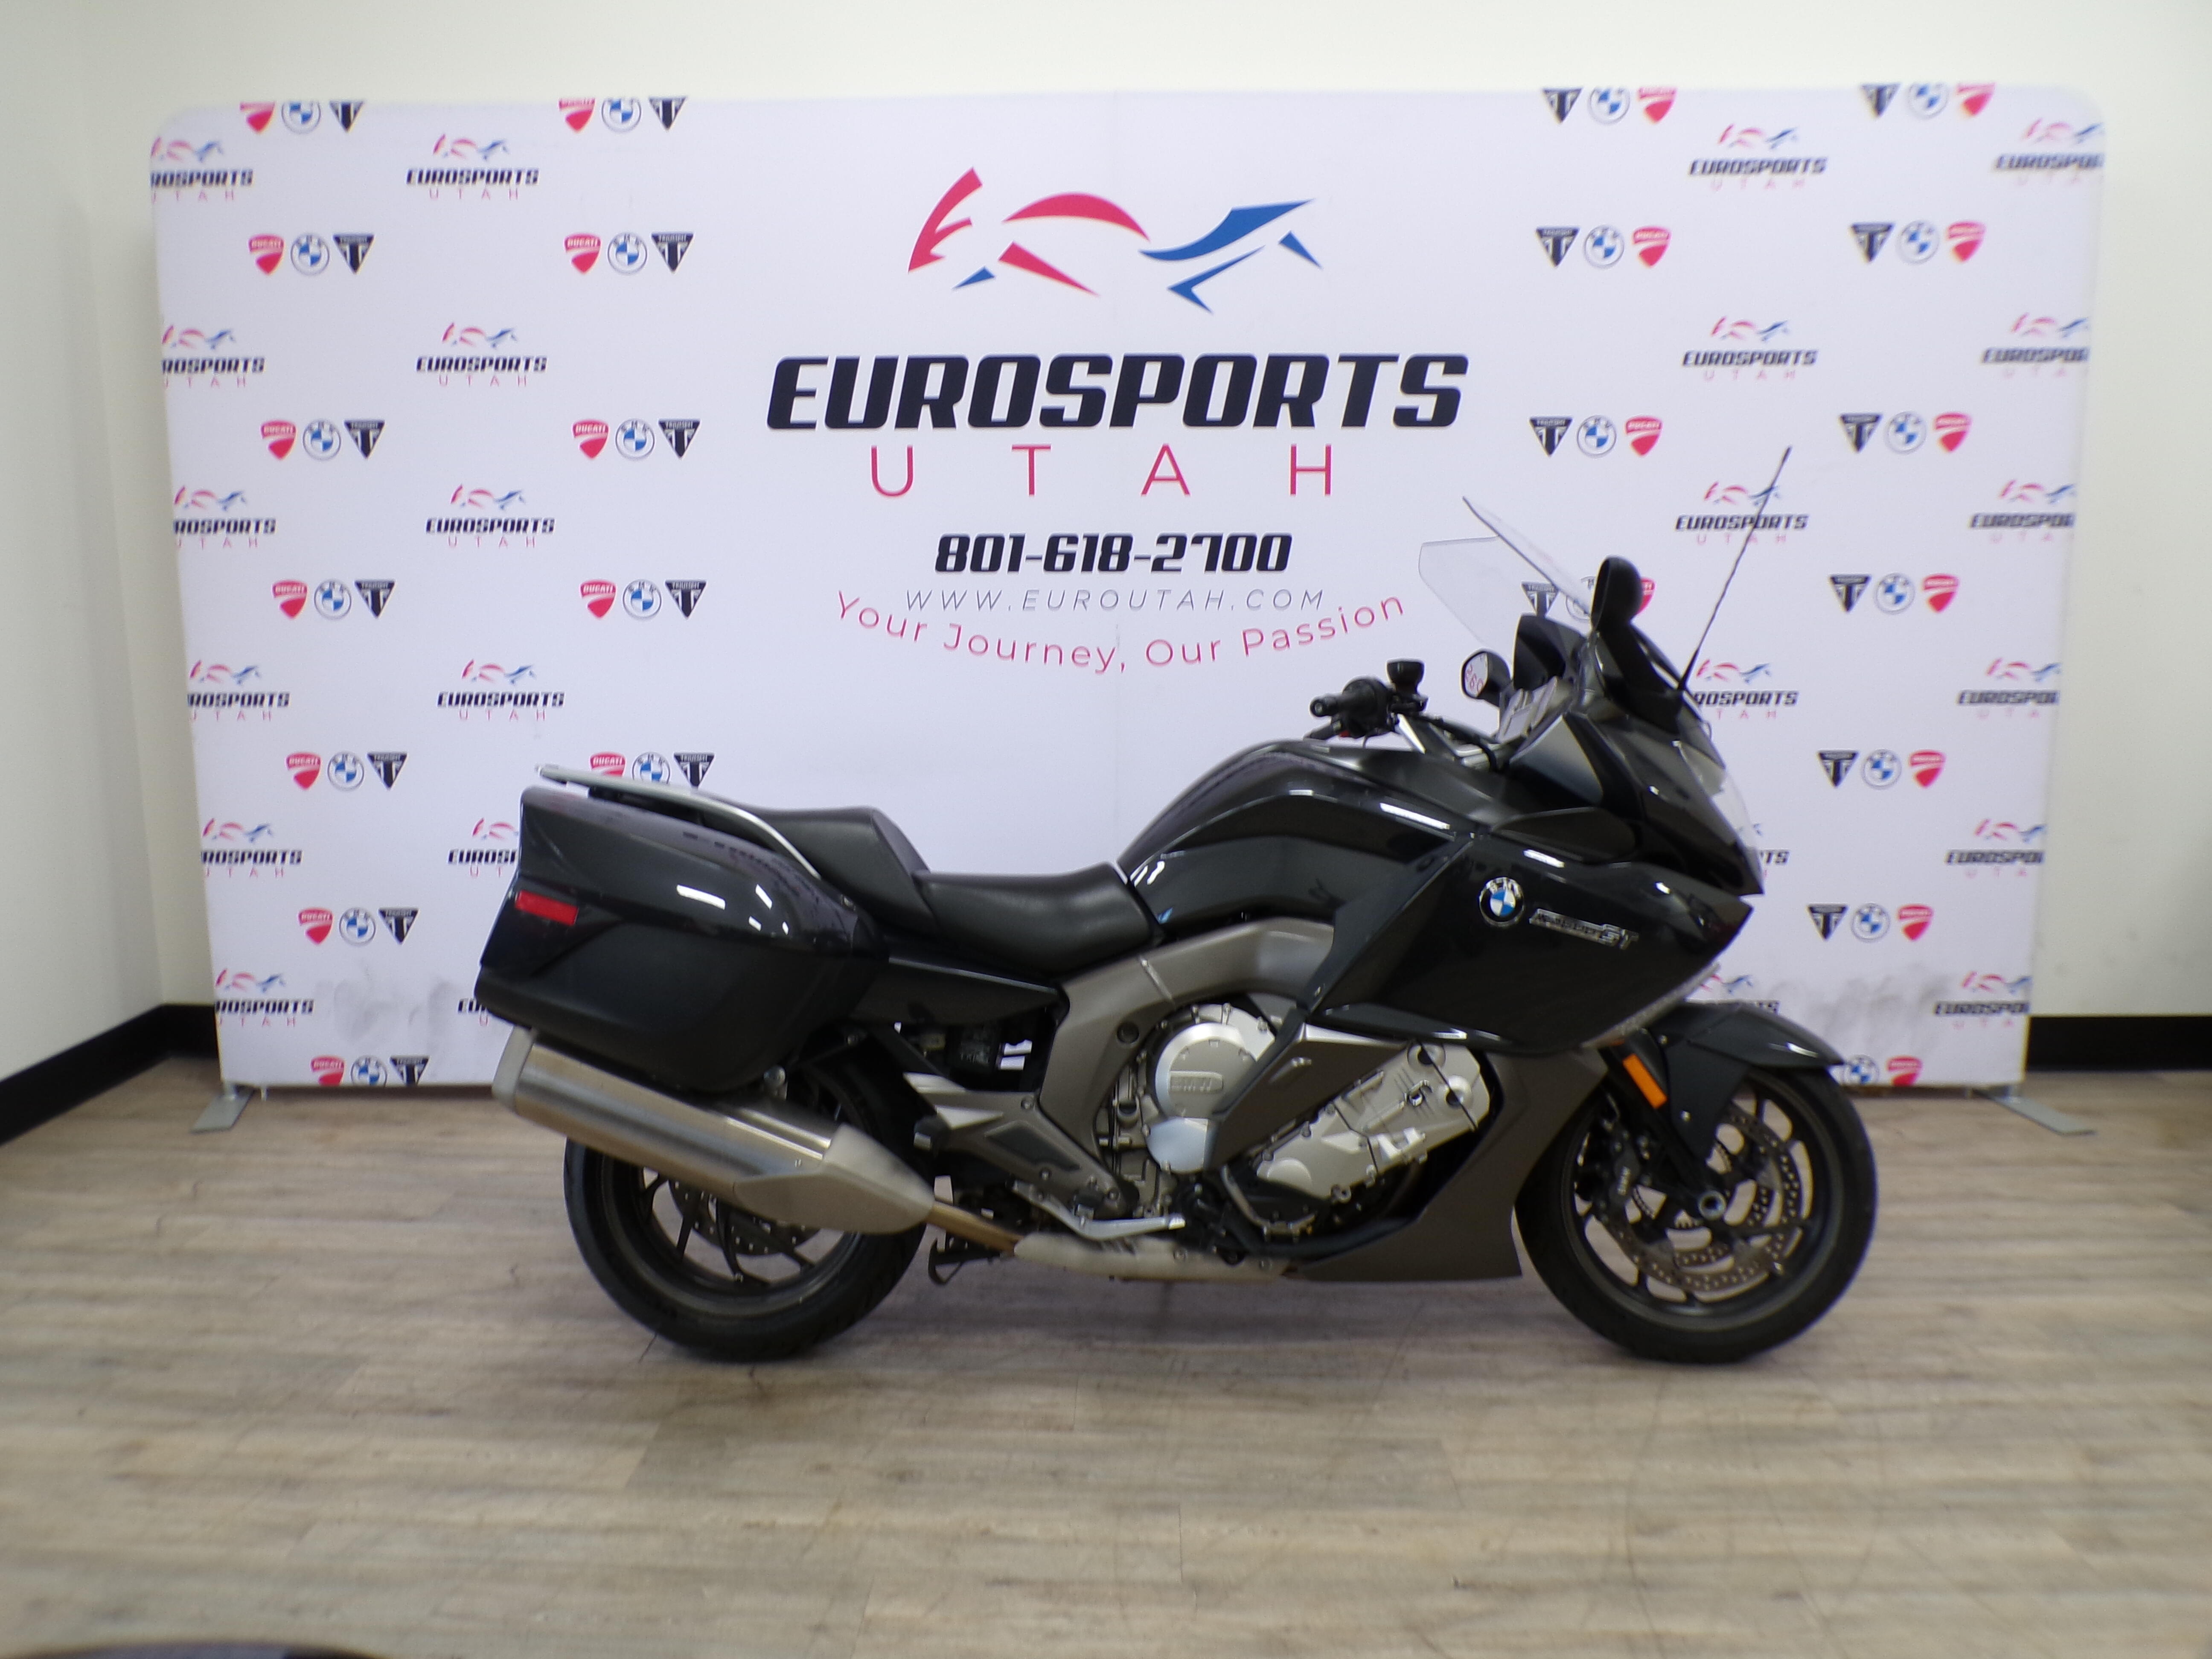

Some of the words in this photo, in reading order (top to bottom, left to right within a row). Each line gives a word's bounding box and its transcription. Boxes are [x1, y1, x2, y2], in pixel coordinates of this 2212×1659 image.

[1690, 157, 1828, 175] EUROSPORTS
[151, 170, 253, 186] ROSPORTS
[407, 169, 539, 184] EUROSPORTS
[429, 187, 518, 200] UTAH
[567, 238, 598, 247] DUCATI
[416, 357, 547, 372] EUROSPORTS
[1682, 349, 1818, 367] EUROSPORTS
[163, 358, 265, 374] ROSPORTS
[439, 375, 527, 387] UTAH
[767, 354, 1469, 431] EUROSPORTS
[575, 424, 606, 434] DUCATI
[871, 444, 1332, 498] UTAH
[174, 519, 276, 534] ROSPORTS
[426, 518, 555, 533] EUROSPORTS
[1676, 515, 1809, 530] EUROSPORTS
[448, 536, 536, 548] UTAH
[934, 533, 1293, 574] 801-618-2700
[582, 584, 613, 593] DUCATI
[906, 589, 1325, 612] WWW.EUROUTAH.COM
[838, 591, 927, 642] Your
[944, 624, 1126, 675] Journey,
[1146, 640, 1222, 667] Our
[1242, 597, 1404, 657] Passion
[188, 693, 289, 708] ROSPORTS
[437, 693, 565, 707] EUROSPORTS
[1693, 690, 1799, 706] ROSPORTS
[459, 709, 546, 722] UTAH
[1716, 709, 1777, 720] TAH
[593, 757, 623, 766] DUCATI
[201, 850, 302, 864] ROSPORTS
[448, 849, 517, 864] EUROS
[469, 866, 502, 878] UT
[214, 1000, 314, 1014] ROSPORTS
